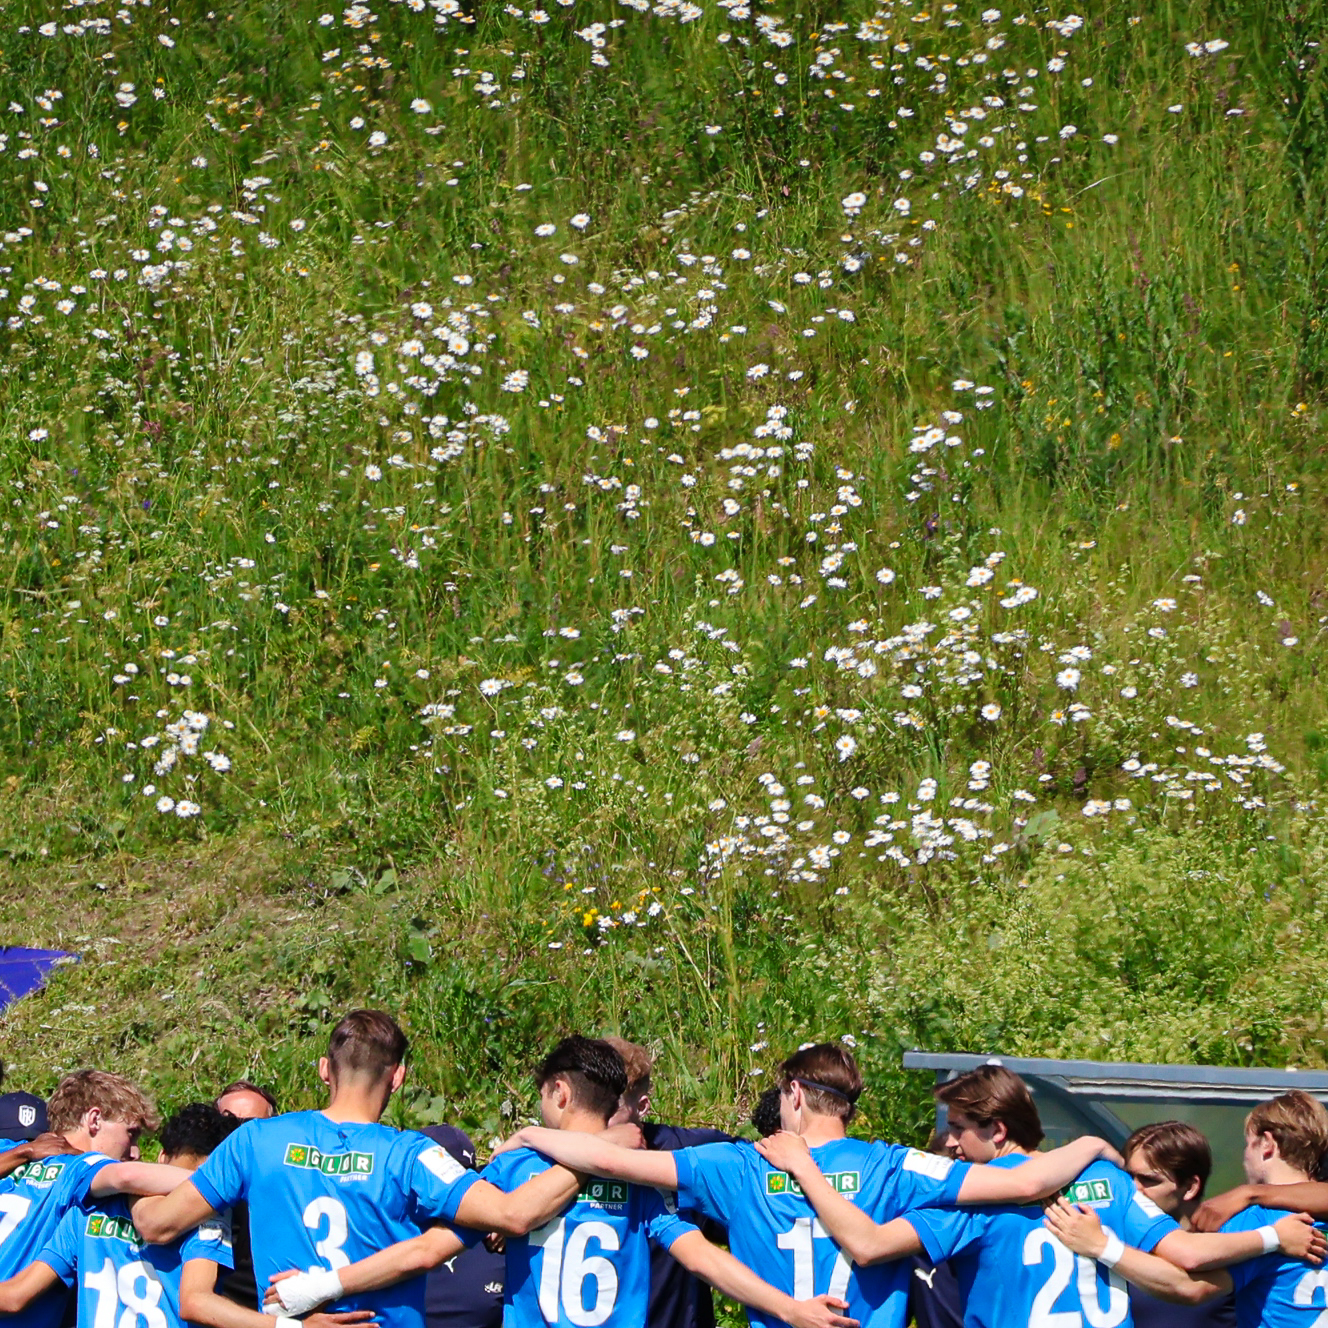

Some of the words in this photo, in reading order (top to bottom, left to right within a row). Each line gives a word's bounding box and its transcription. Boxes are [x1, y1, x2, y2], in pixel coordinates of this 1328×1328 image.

[303, 1195, 351, 1273] 3
[528, 1217, 620, 1327] 16
[777, 1217, 854, 1316] 17
